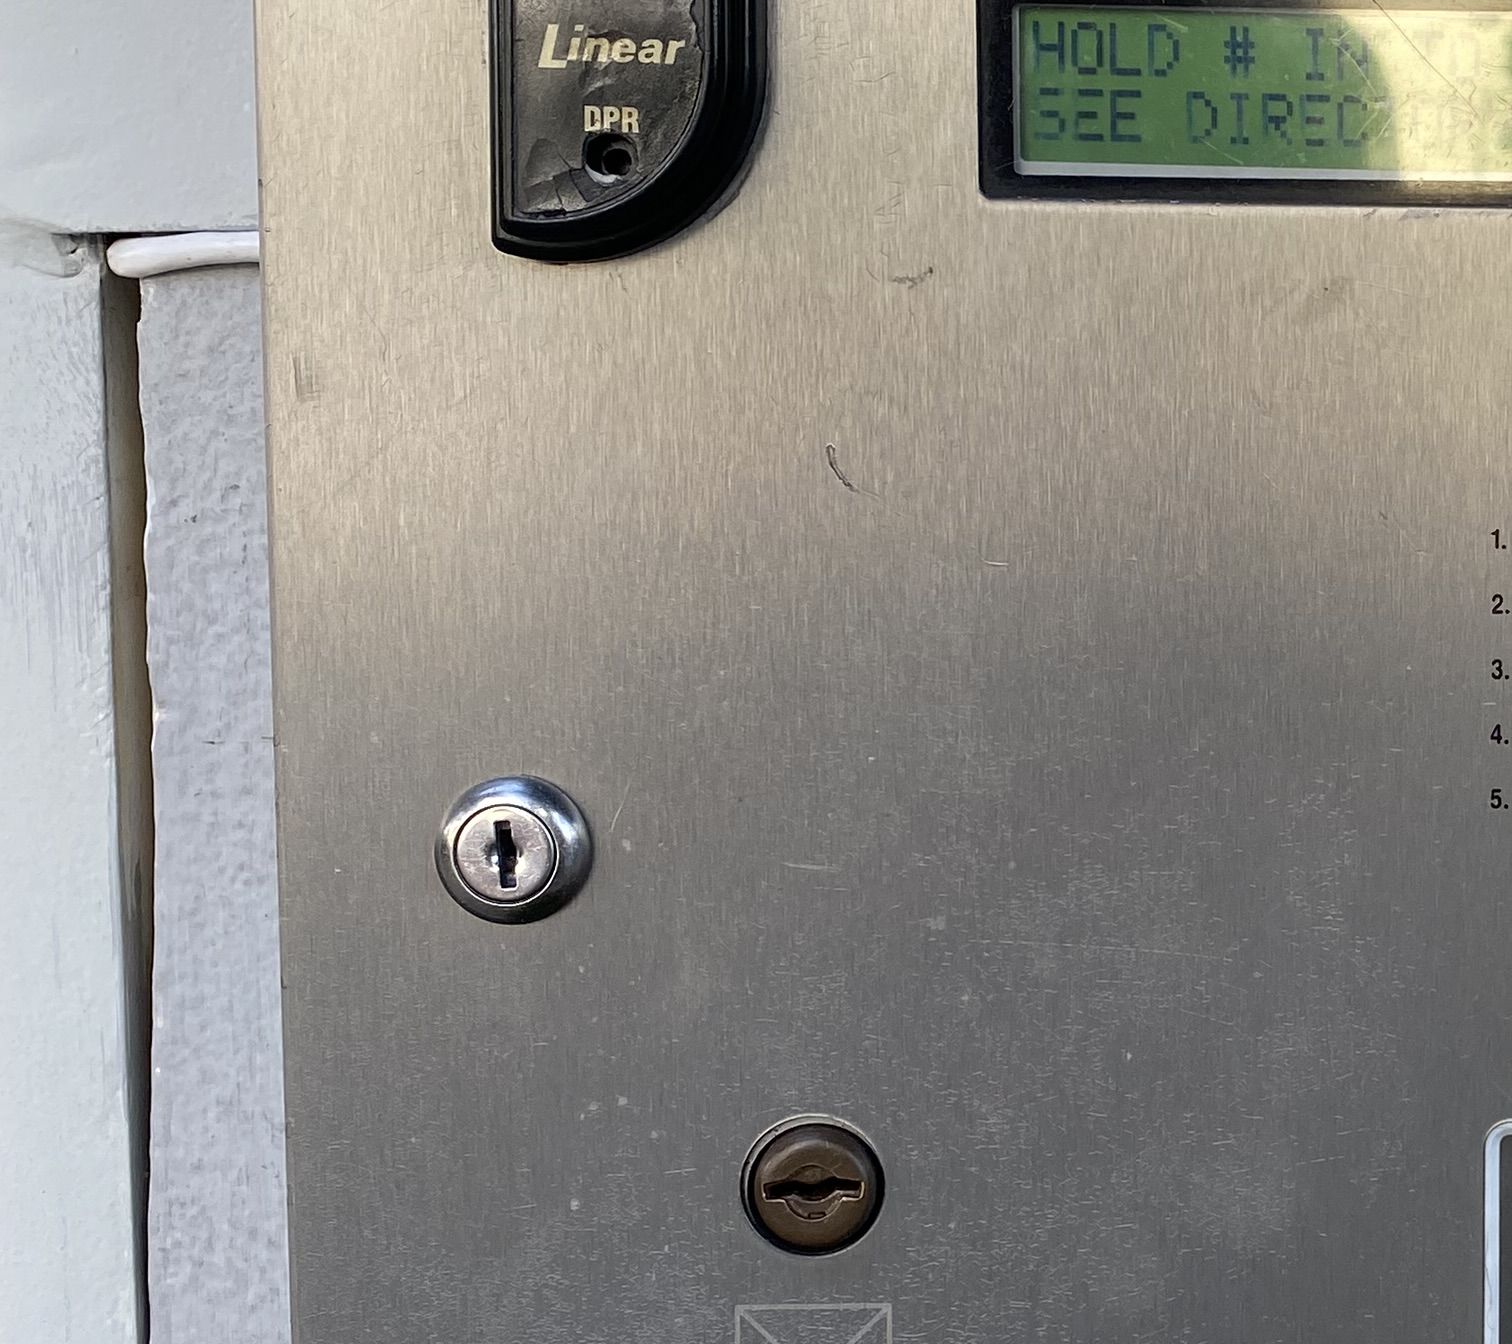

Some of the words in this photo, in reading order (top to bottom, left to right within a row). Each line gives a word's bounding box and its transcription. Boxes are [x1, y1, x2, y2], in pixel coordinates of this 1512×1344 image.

[538, 22, 685, 70] Linear
[1031, 20, 1181, 78] HOLD
[1224, 25, 1256, 79] #
[583, 104, 640, 134] DPR
[1031, 87, 1142, 144] SEE
[1491, 529, 1507, 550] 1.
[1491, 593, 1510, 615] 2.
[1491, 658, 1510, 680] 3.
[1490, 723, 1509, 745] 4.
[1490, 788, 1509, 810] 5.
